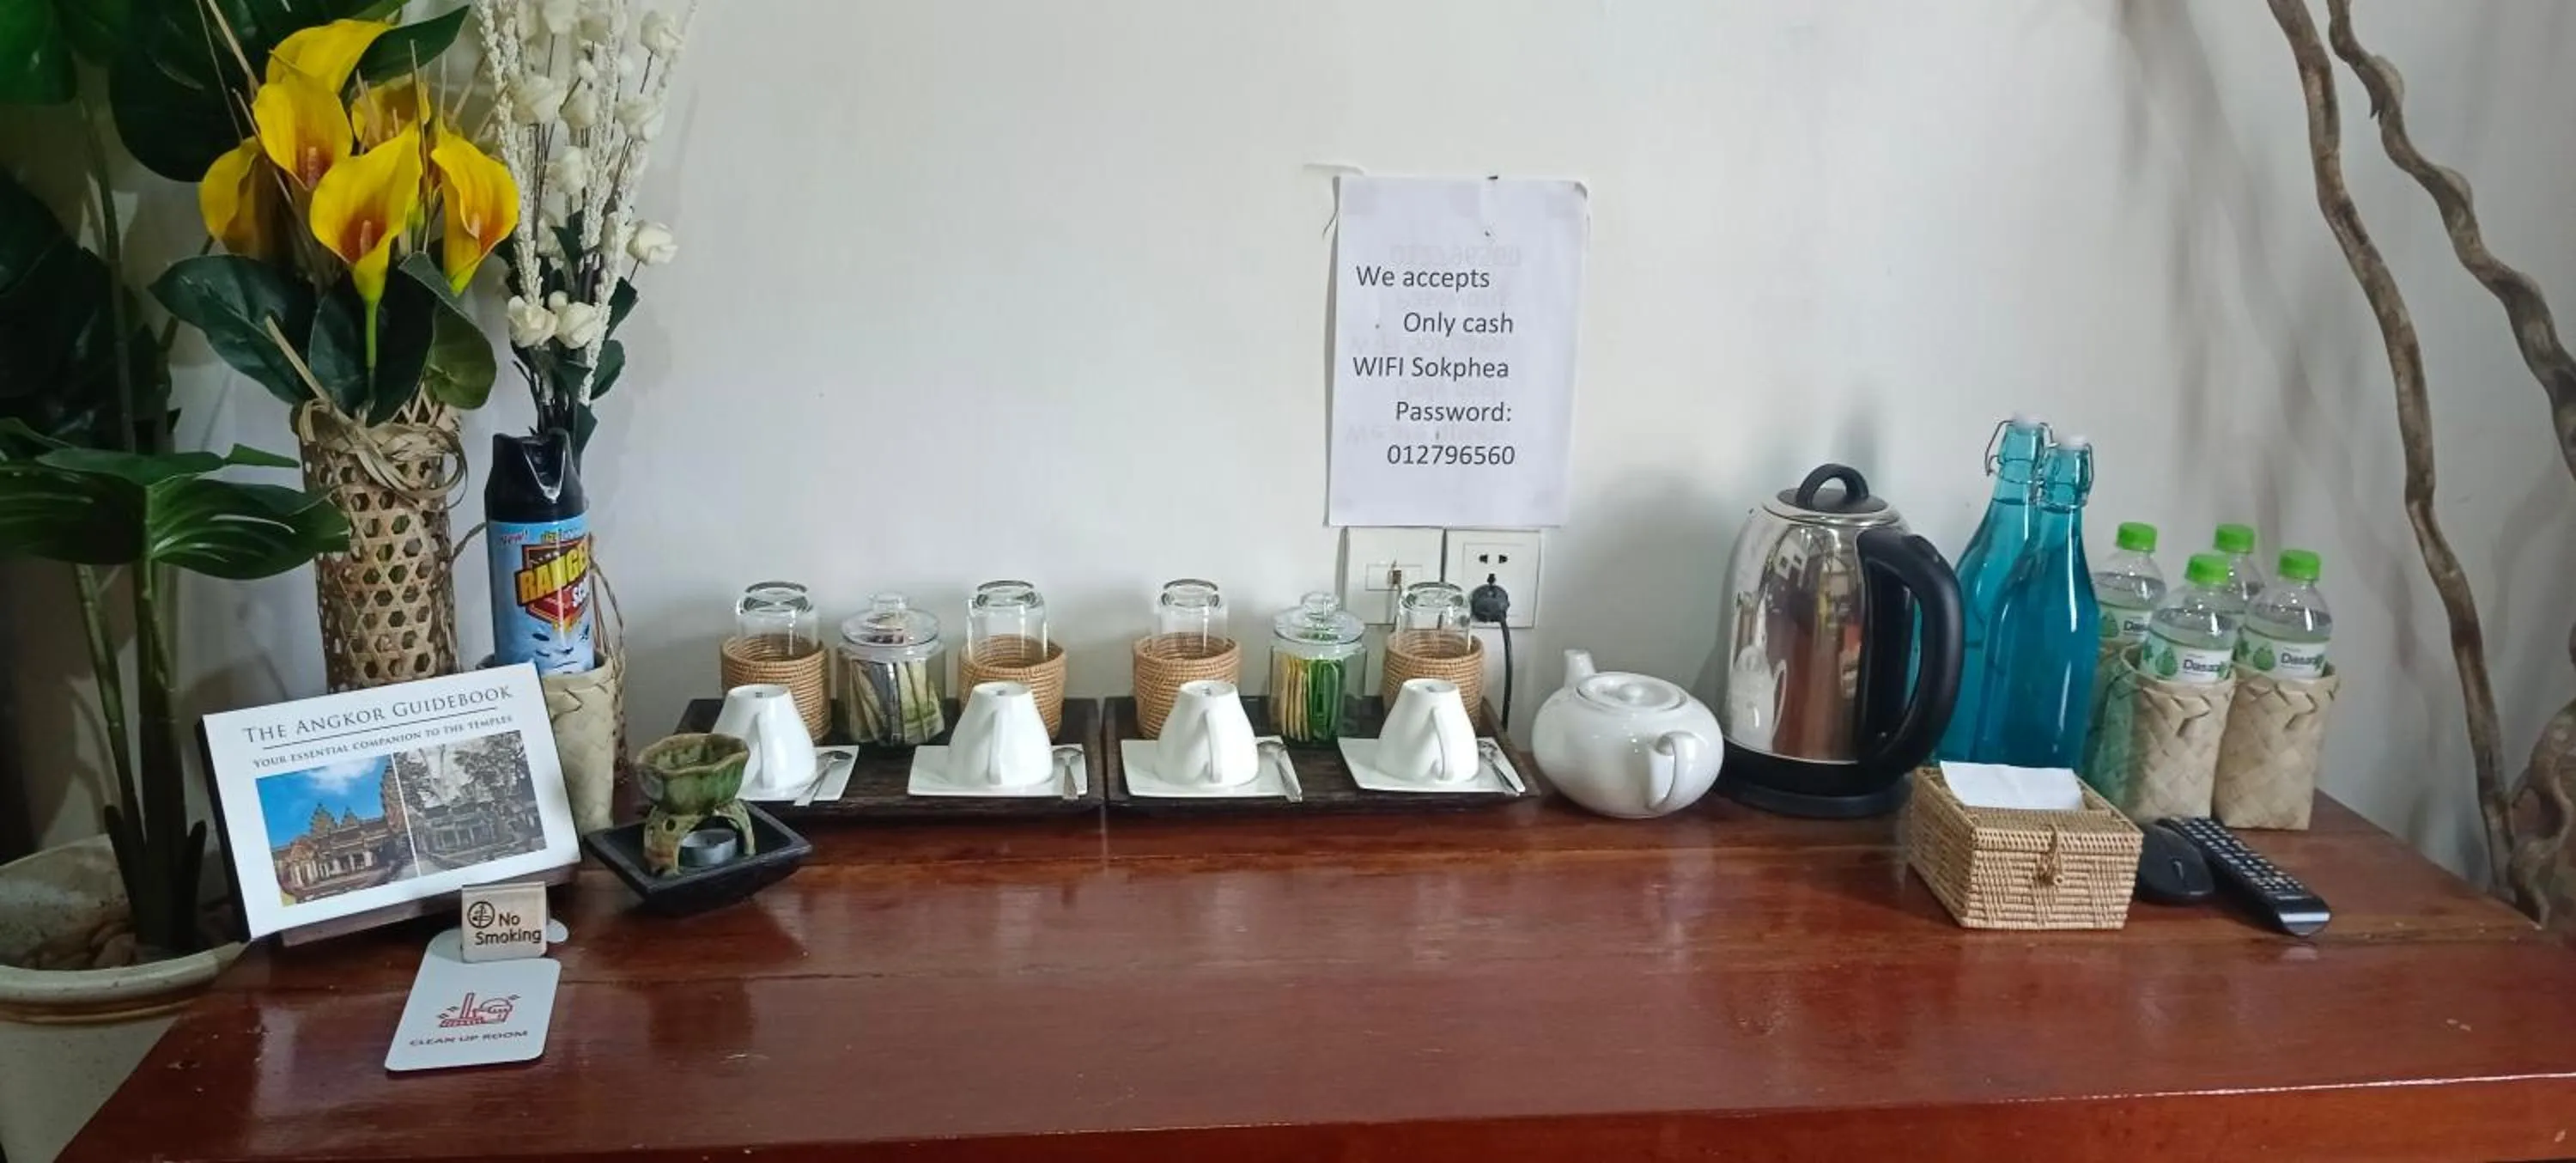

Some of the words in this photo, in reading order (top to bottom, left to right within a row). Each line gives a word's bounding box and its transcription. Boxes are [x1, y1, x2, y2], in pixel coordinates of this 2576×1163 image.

[1356, 265, 1395, 287] We
[1402, 269, 1490, 293] accepts
[1403, 311, 1456, 338] Only
[1462, 311, 1514, 334] cash
[1352, 356, 1404, 377] WIFI
[1411, 356, 1509, 382] Sokphea
[1395, 401, 1512, 423] Password:
[1387, 444, 1516, 466] 012796560
[241, 724, 287, 743] THE
[295, 707, 386, 734] ANGKOR
[392, 685, 513, 717] GUIDEBOOK
[252, 755, 287, 768] YOUR
[291, 745, 349, 762] ESSENTIAL
[352, 730, 422, 751] COMPANION
[425, 727, 440, 738] TO
[443, 723, 464, 734] THE
[467, 714, 513, 730] TEMPLES
[498, 911, 521, 928] No
[475, 928, 543, 947] Smoking
[409, 1035, 457, 1046] CLEAN
[459, 1033, 479, 1043] UP
[482, 1029, 529, 1040] ROOM
